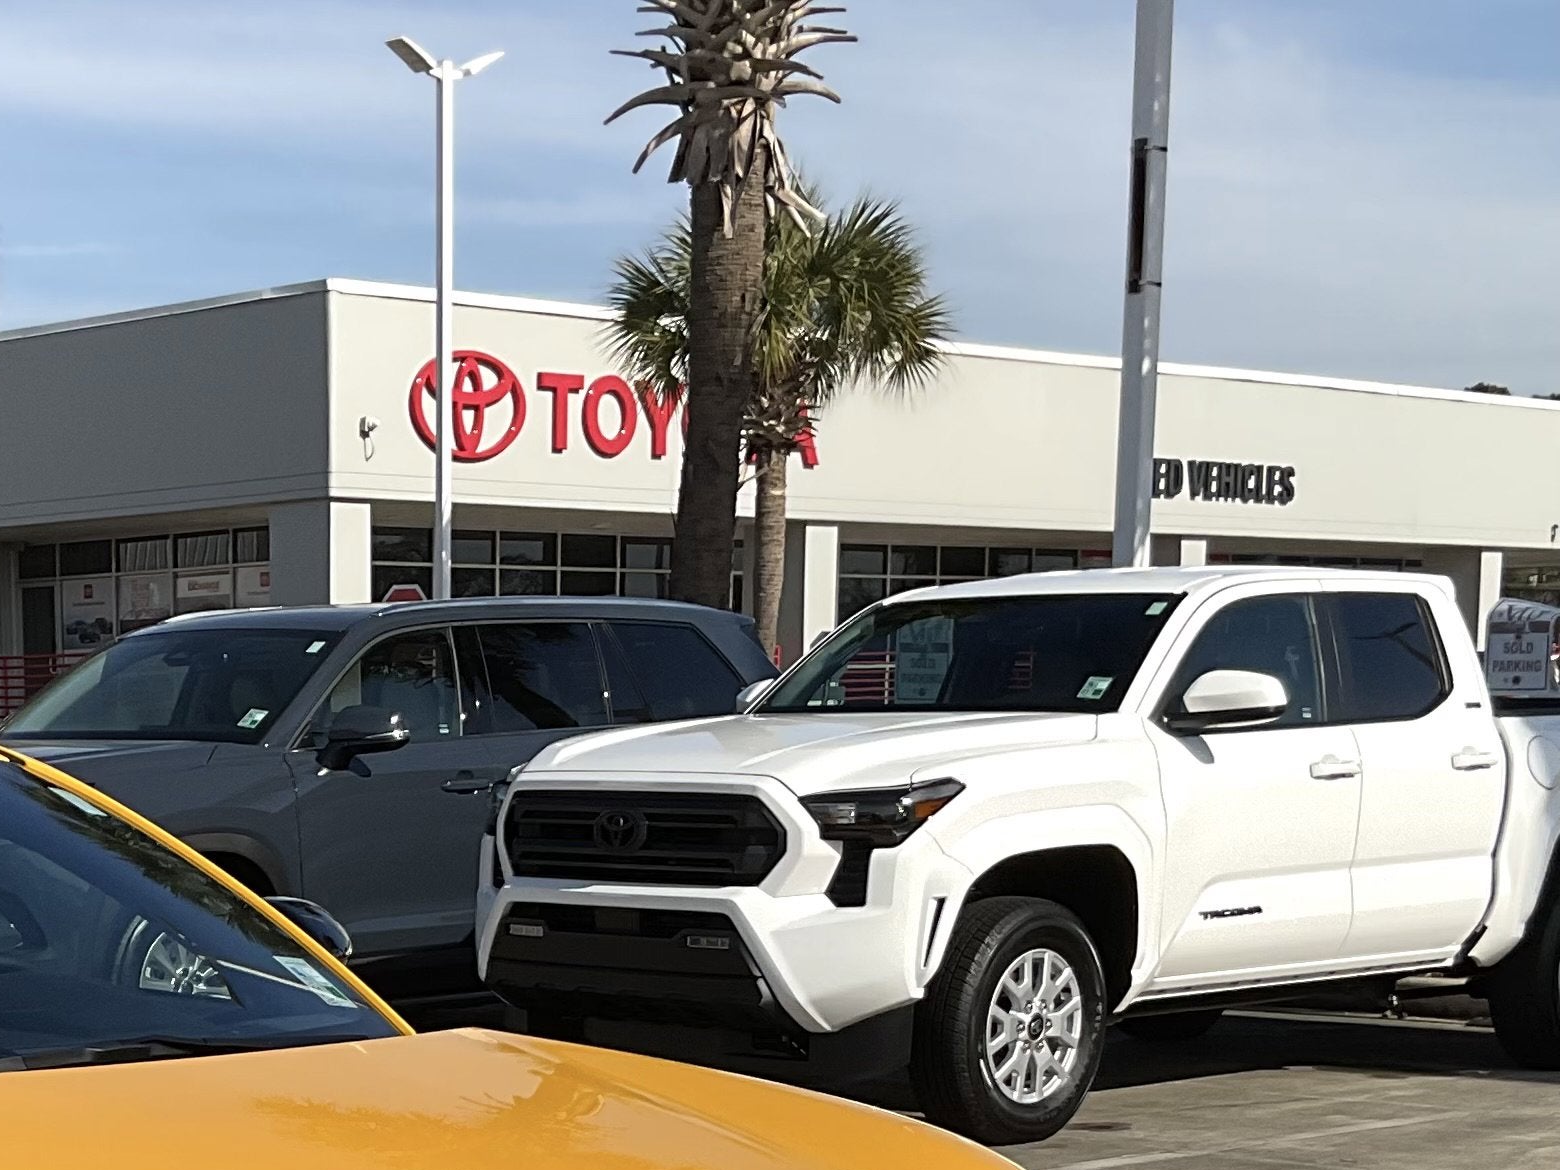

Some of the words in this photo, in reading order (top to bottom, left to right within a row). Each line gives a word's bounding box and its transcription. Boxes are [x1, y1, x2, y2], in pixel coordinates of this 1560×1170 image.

[537, 371, 820, 469] TOYA
[1152, 457, 1184, 499] ED
[1187, 459, 1296, 507] VEHICLES
[1503, 642, 1534, 654] SOLD
[1492, 659, 1543, 673] PARKING
